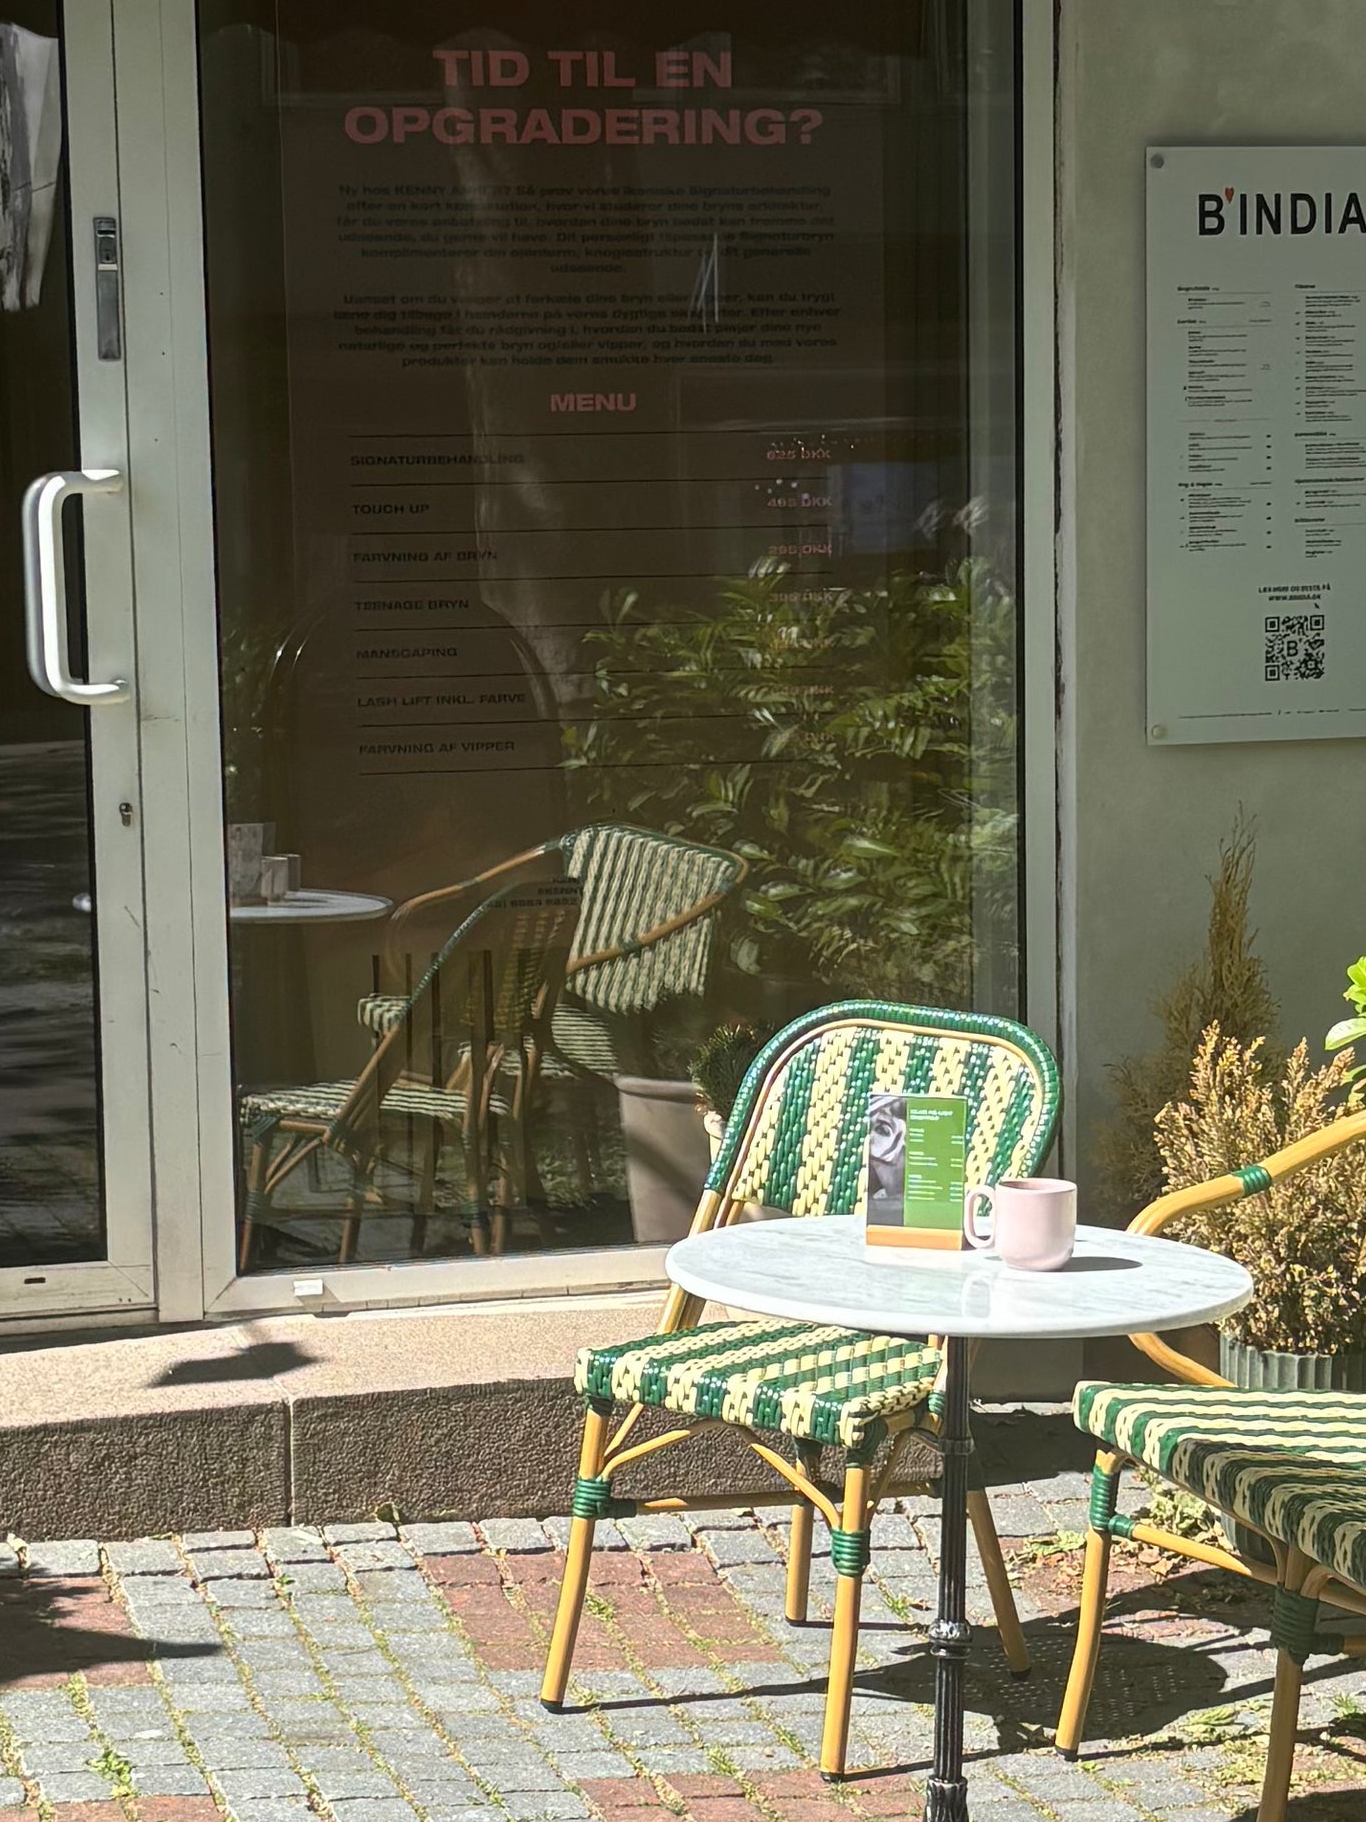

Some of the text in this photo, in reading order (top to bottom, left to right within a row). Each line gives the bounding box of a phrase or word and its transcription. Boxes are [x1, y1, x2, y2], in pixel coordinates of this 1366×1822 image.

[434, 48, 733, 89] TID TIL EN
[343, 106, 824, 147] OPGRADERING?
[549, 393, 638, 413] MENU
[352, 504, 405, 515] TOUCH
[409, 504, 430, 515] UP
[353, 552, 428, 562] FARVNING
[354, 600, 425, 611] TEENAGE
[428, 599, 469, 610] BRYN
[356, 647, 458, 659] MANSCAPING
[479, 693, 526, 705] FARVE
[359, 743, 434, 755] FARVNING
[461, 740, 515, 753] VIPPER
